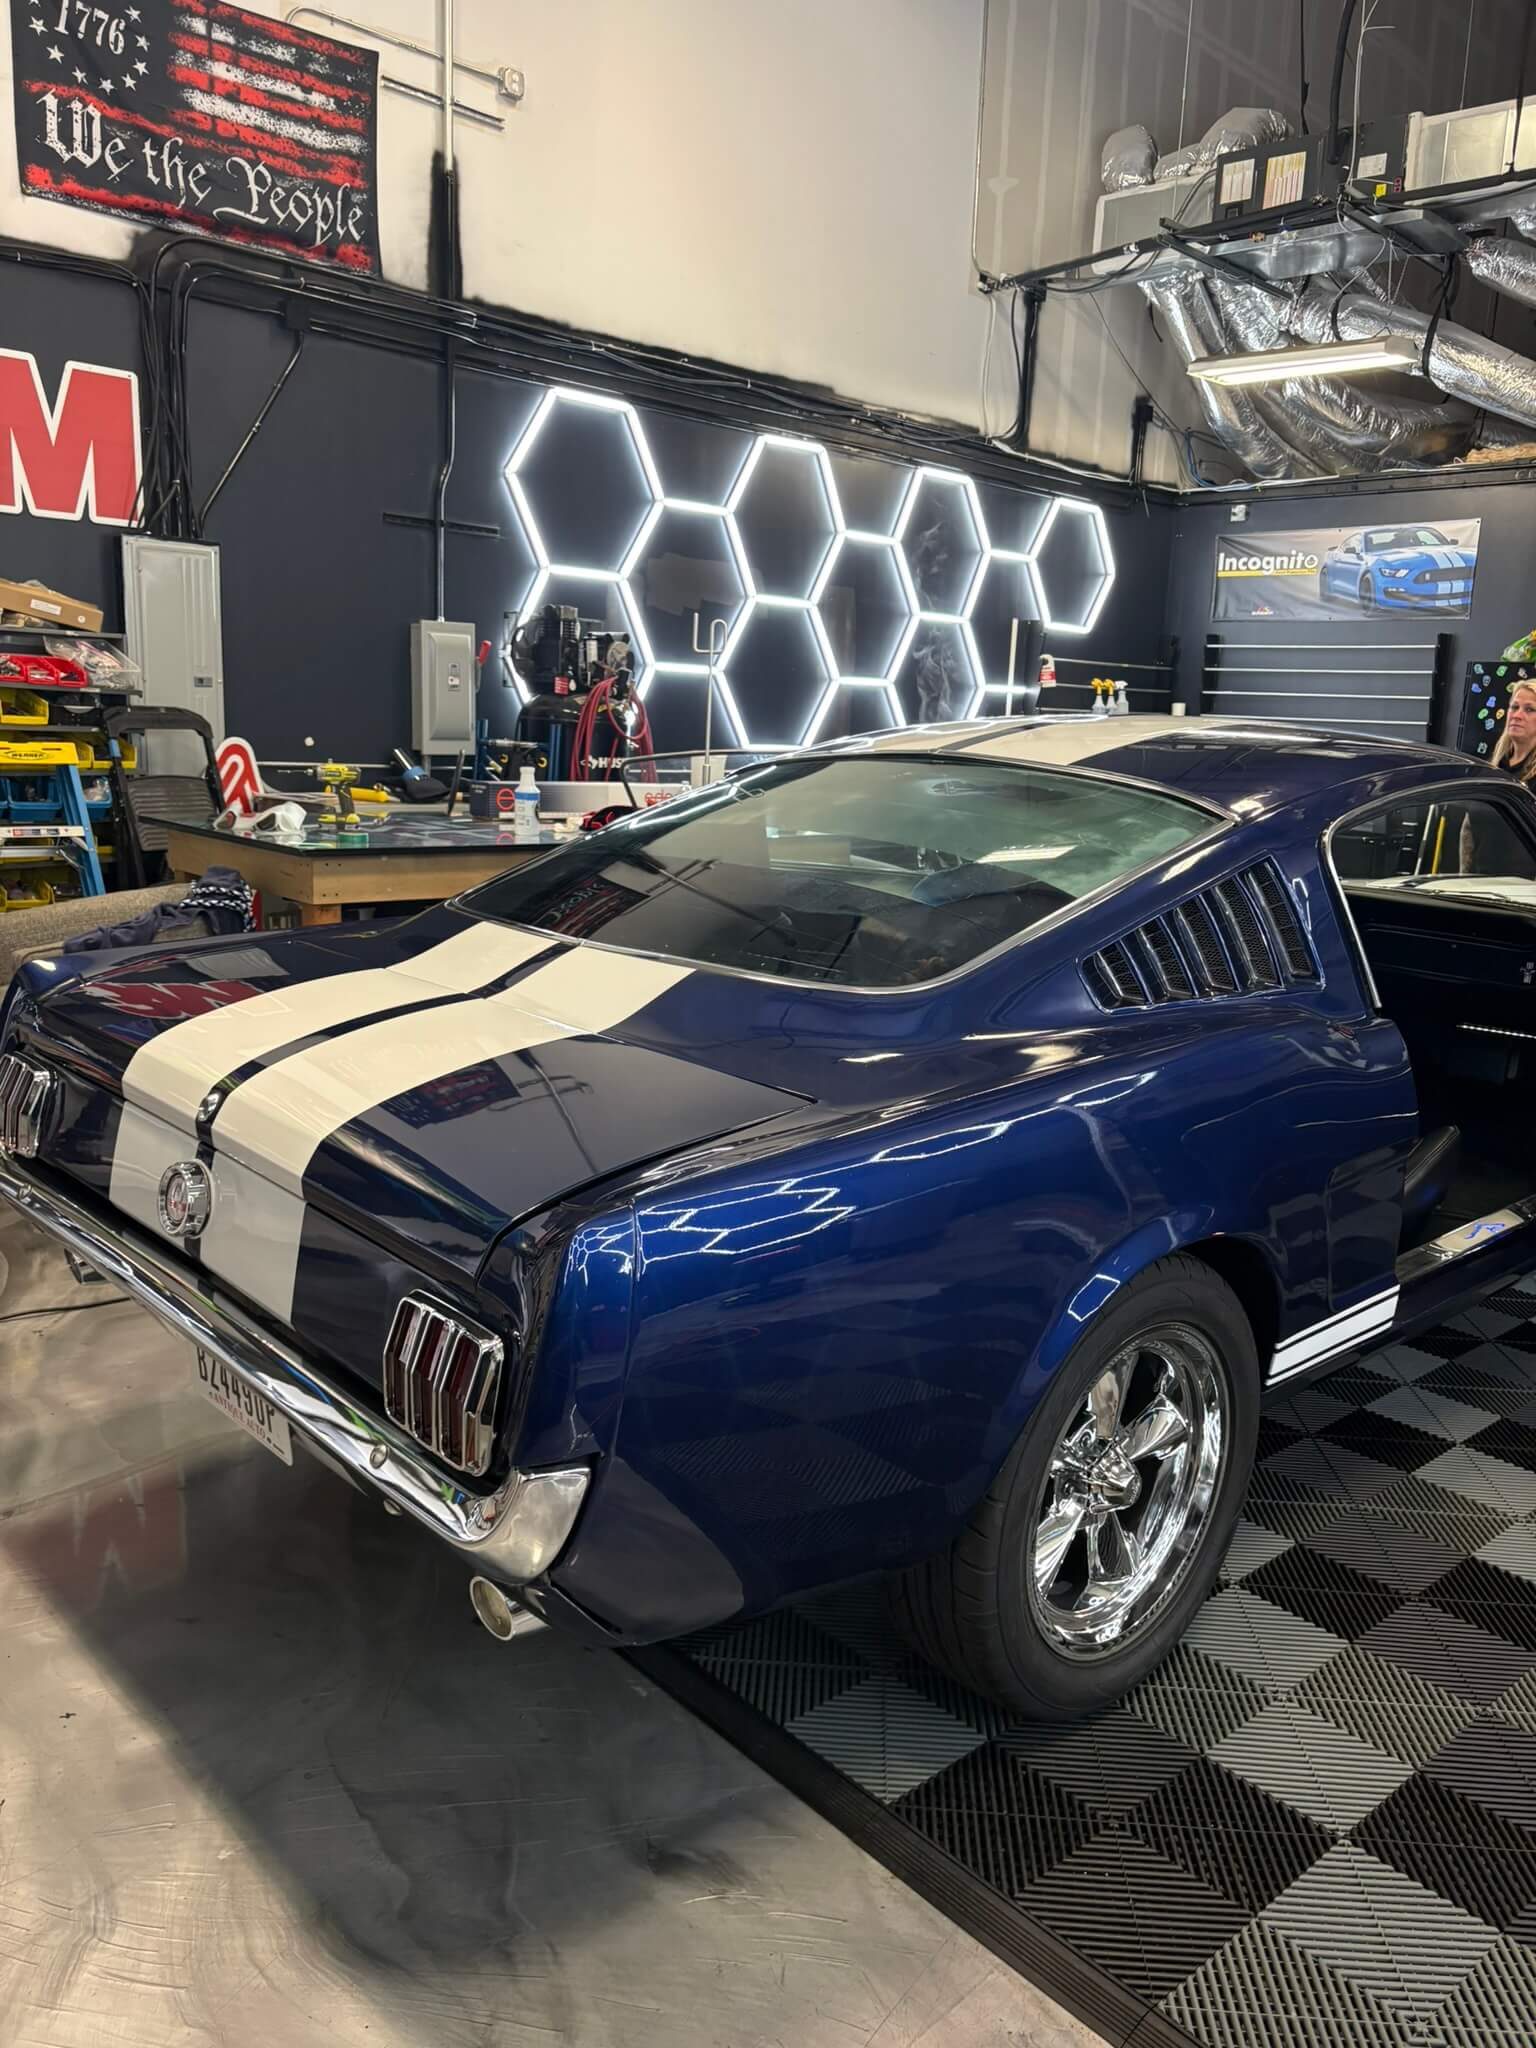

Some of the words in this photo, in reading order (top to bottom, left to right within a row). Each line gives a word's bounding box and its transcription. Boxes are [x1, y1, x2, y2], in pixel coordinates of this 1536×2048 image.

[53, 0, 127, 56] 1776
[35, 87, 135, 182] We
[142, 136, 212, 210] the
[213, 156, 367, 249] People
[1217, 549, 1319, 576] Incognito
[598, 756, 625, 769] HUS
